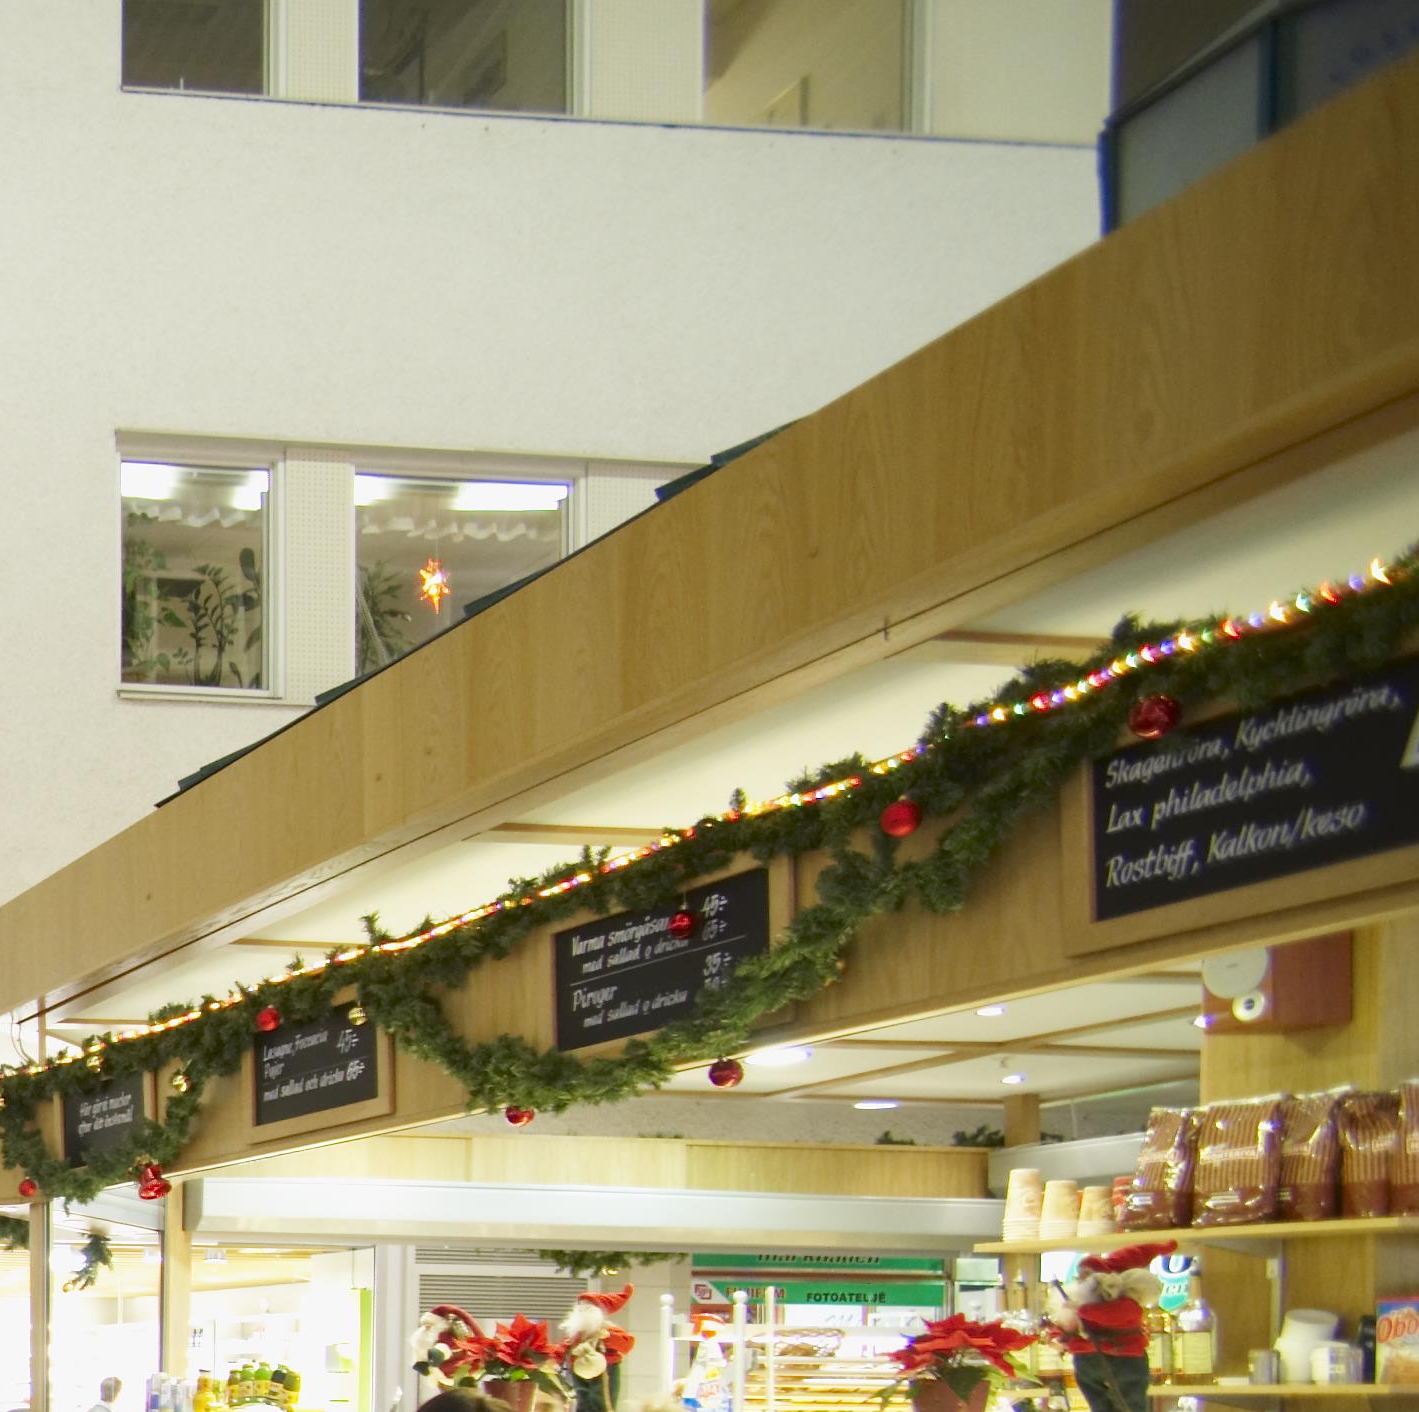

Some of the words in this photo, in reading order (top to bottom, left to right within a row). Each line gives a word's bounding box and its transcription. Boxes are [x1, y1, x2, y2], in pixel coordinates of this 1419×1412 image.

[1106, 804, 1143, 833] Lax
[1151, 761, 1313, 829] philadelphia,
[1207, 803, 1367, 864] Kalkon/keso
